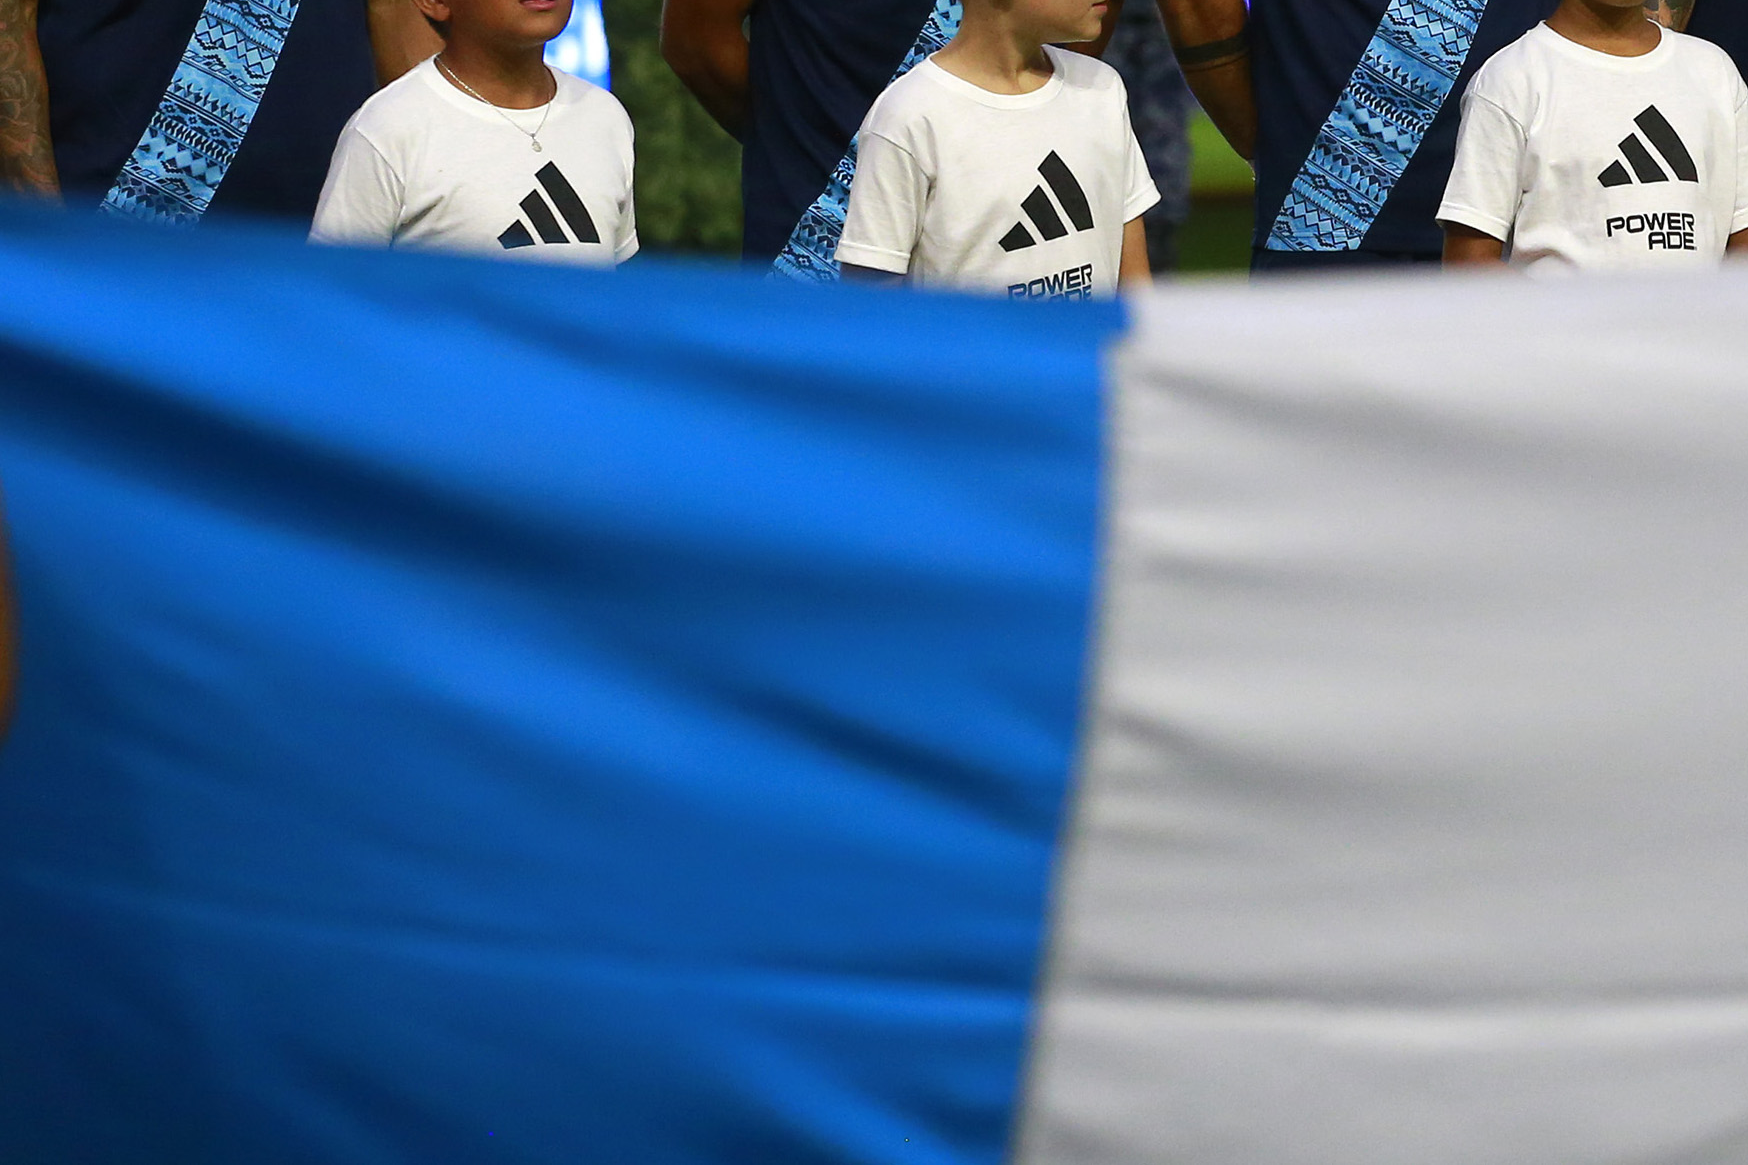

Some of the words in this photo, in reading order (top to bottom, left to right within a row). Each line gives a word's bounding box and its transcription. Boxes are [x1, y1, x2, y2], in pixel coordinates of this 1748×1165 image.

[1606, 212, 1695, 237] POWER
[1648, 231, 1695, 250] ADE
[1007, 263, 1093, 301] POWER
